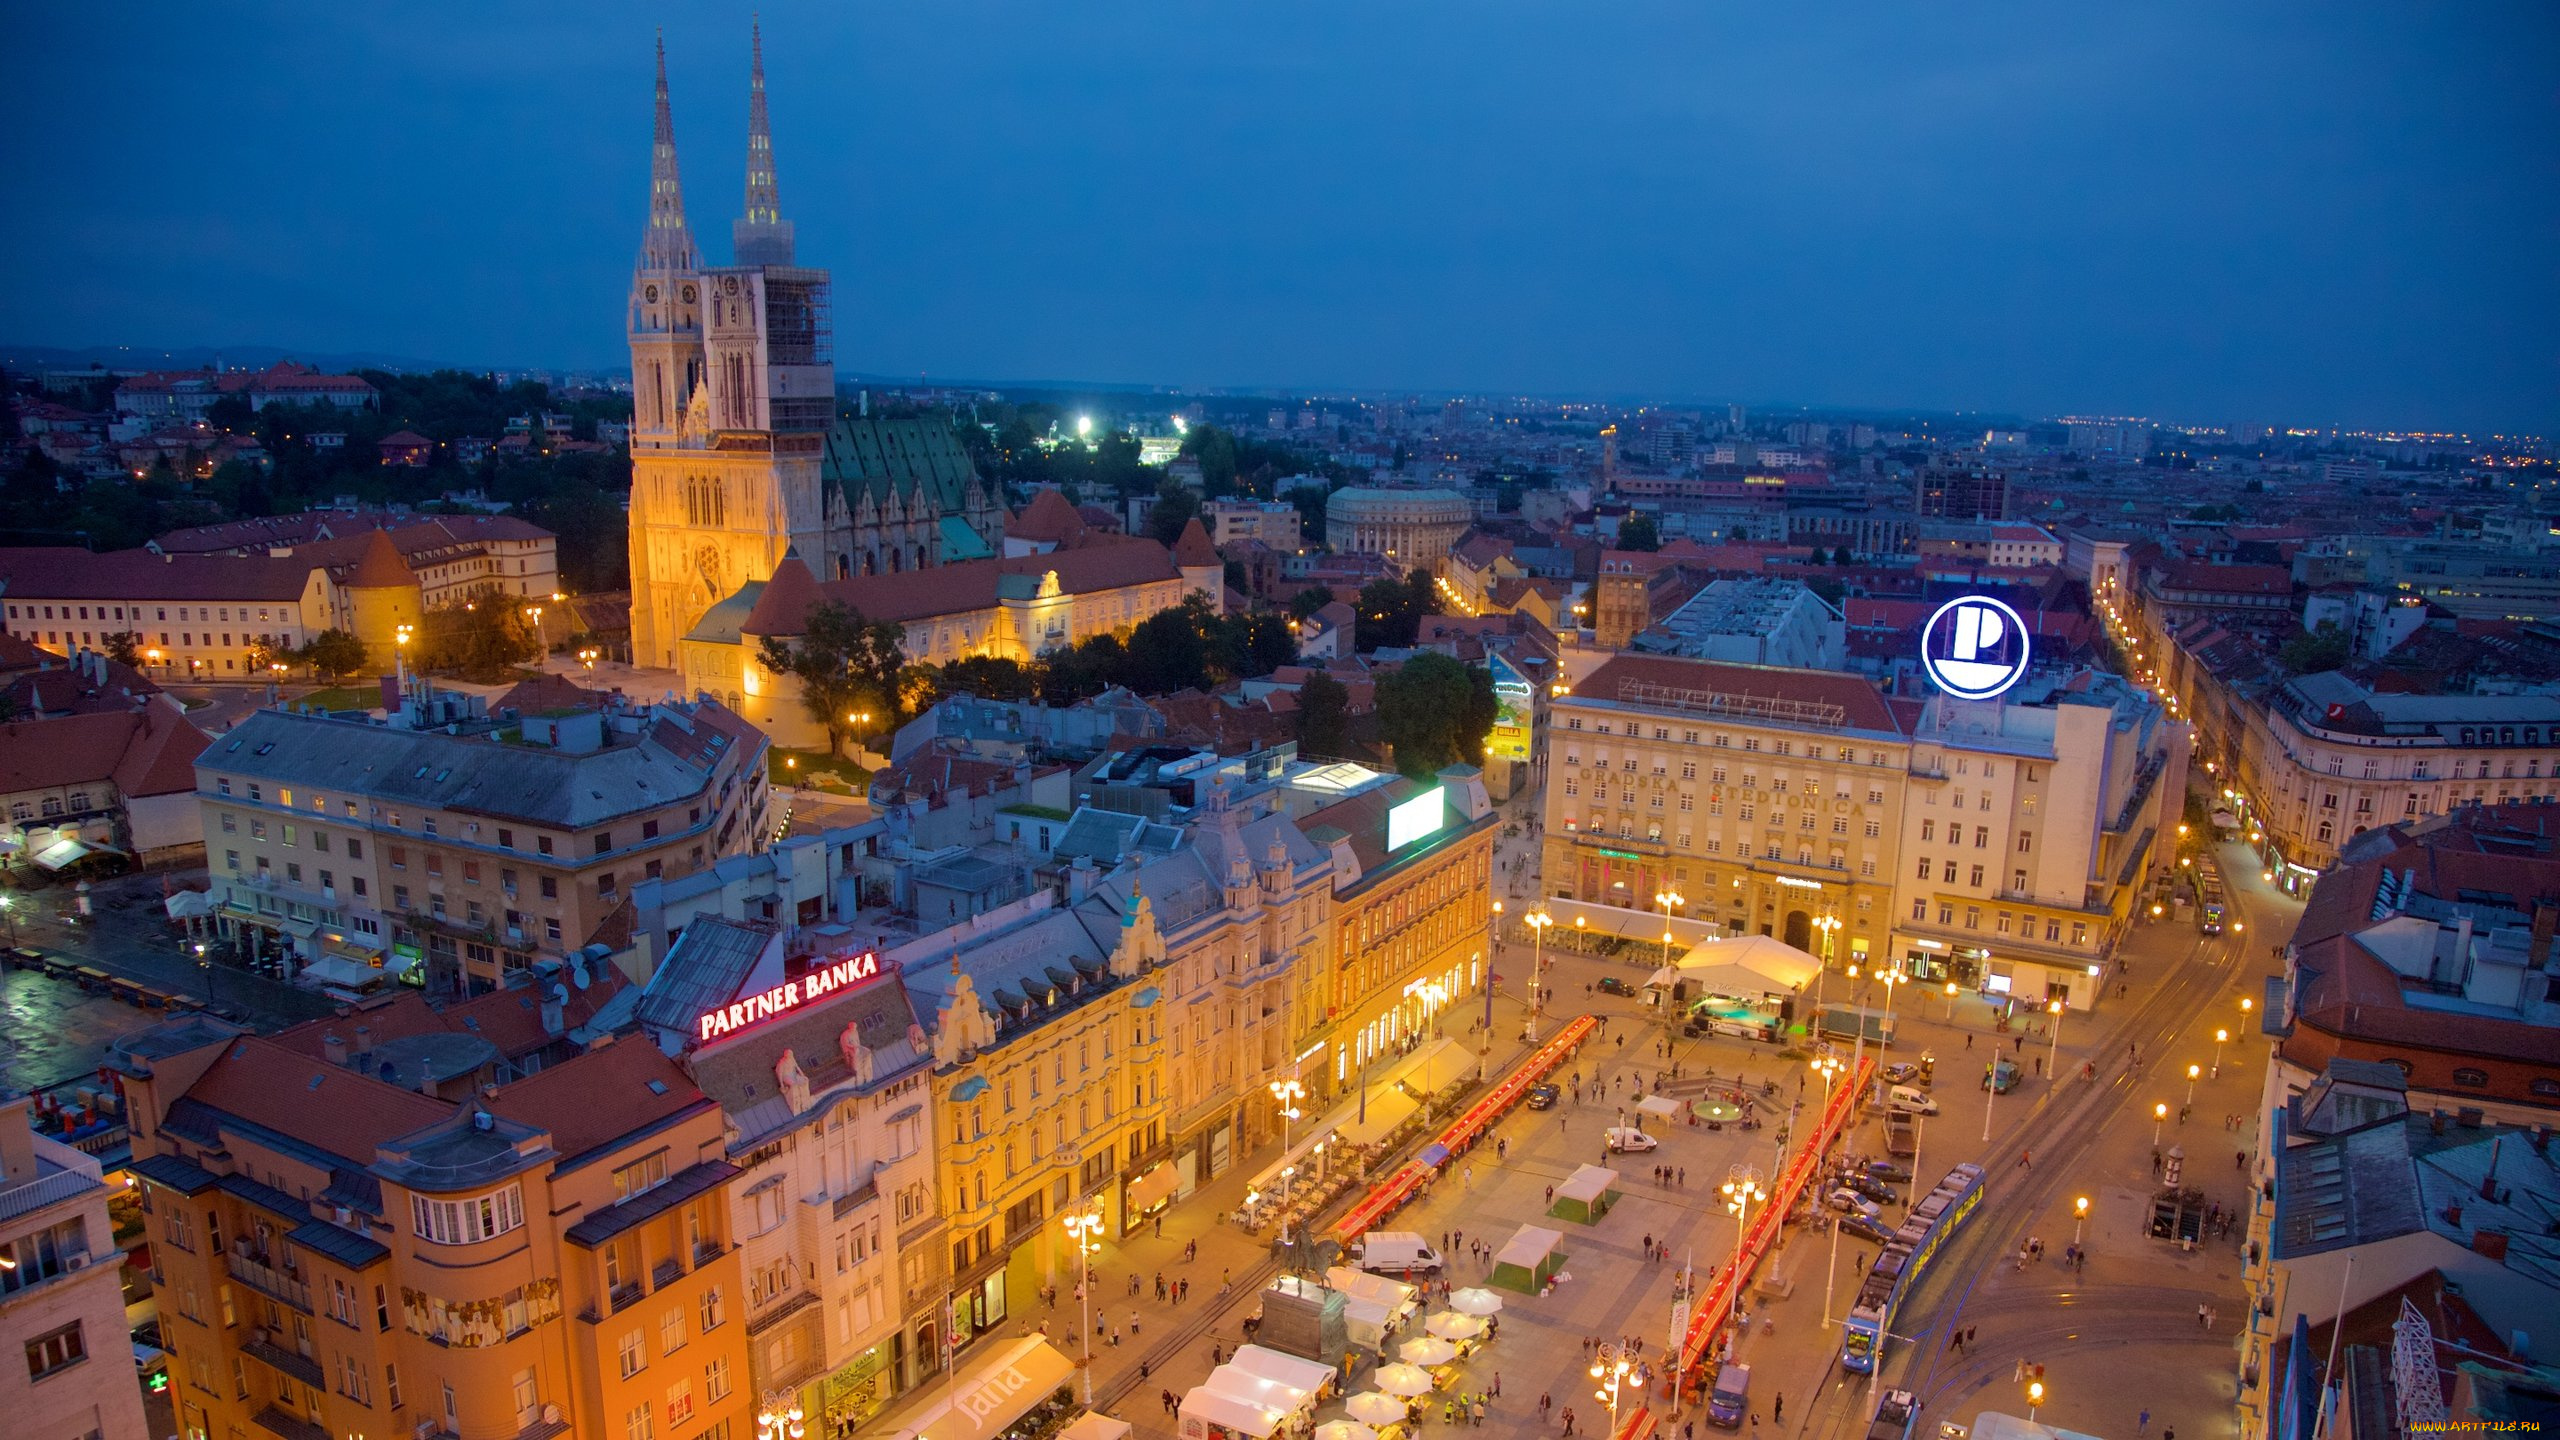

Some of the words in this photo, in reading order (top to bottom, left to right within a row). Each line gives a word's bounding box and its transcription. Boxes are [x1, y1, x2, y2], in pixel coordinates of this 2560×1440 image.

[1498, 727, 1520, 736] BILLA
[1580, 768, 1679, 792] GRADSKA
[700, 982, 800, 1041] PARTNER
[805, 952, 877, 1000] BANKA
